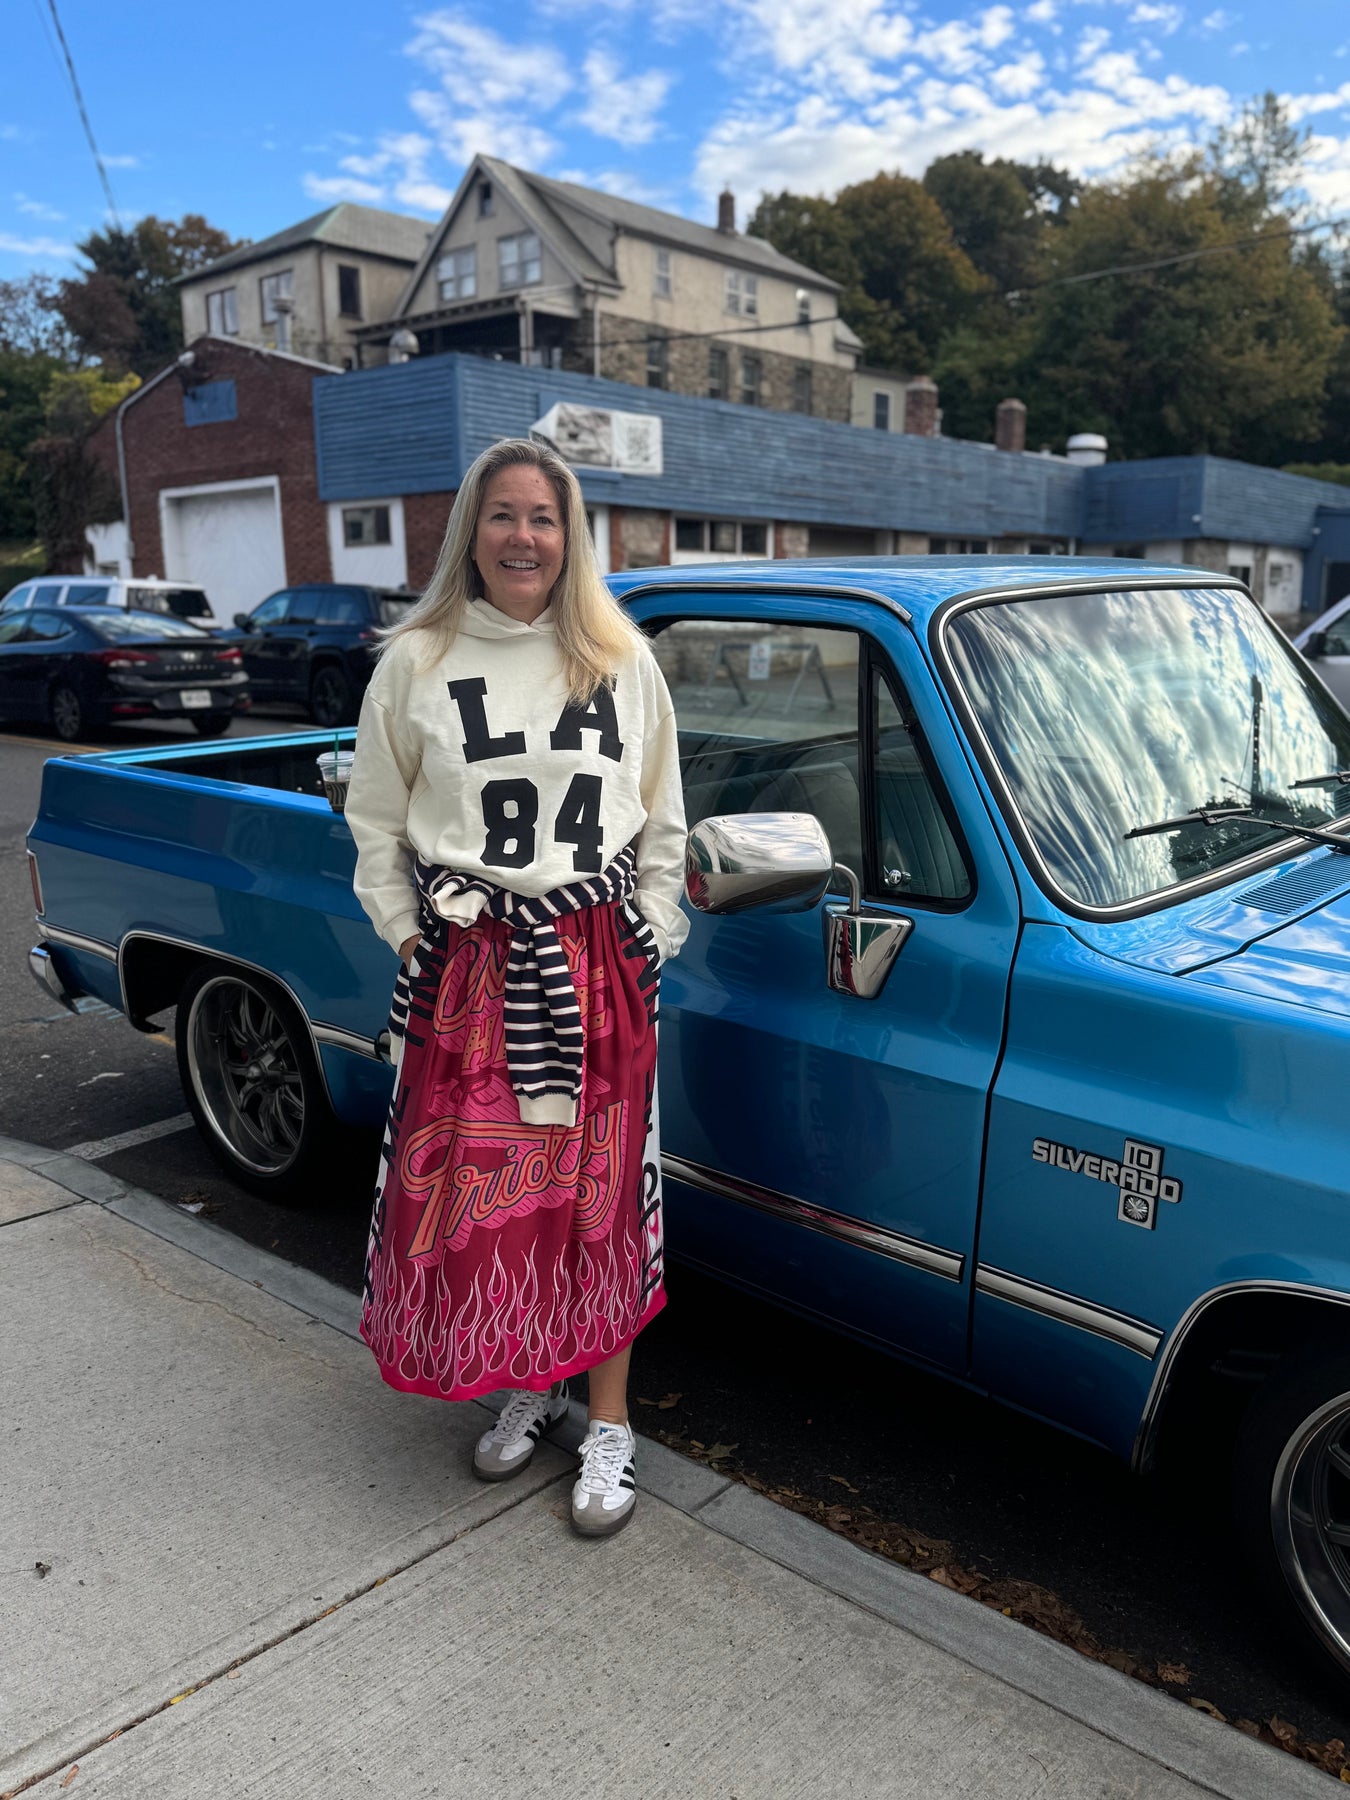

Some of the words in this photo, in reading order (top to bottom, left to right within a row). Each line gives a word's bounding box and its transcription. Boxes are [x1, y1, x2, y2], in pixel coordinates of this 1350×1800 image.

[447, 674, 624, 763] LA
[480, 773, 604, 873] 84
[433, 928, 588, 1035] ONY
[461, 966, 608, 1074] HE
[1032, 1138, 1182, 1204] SILVERADO
